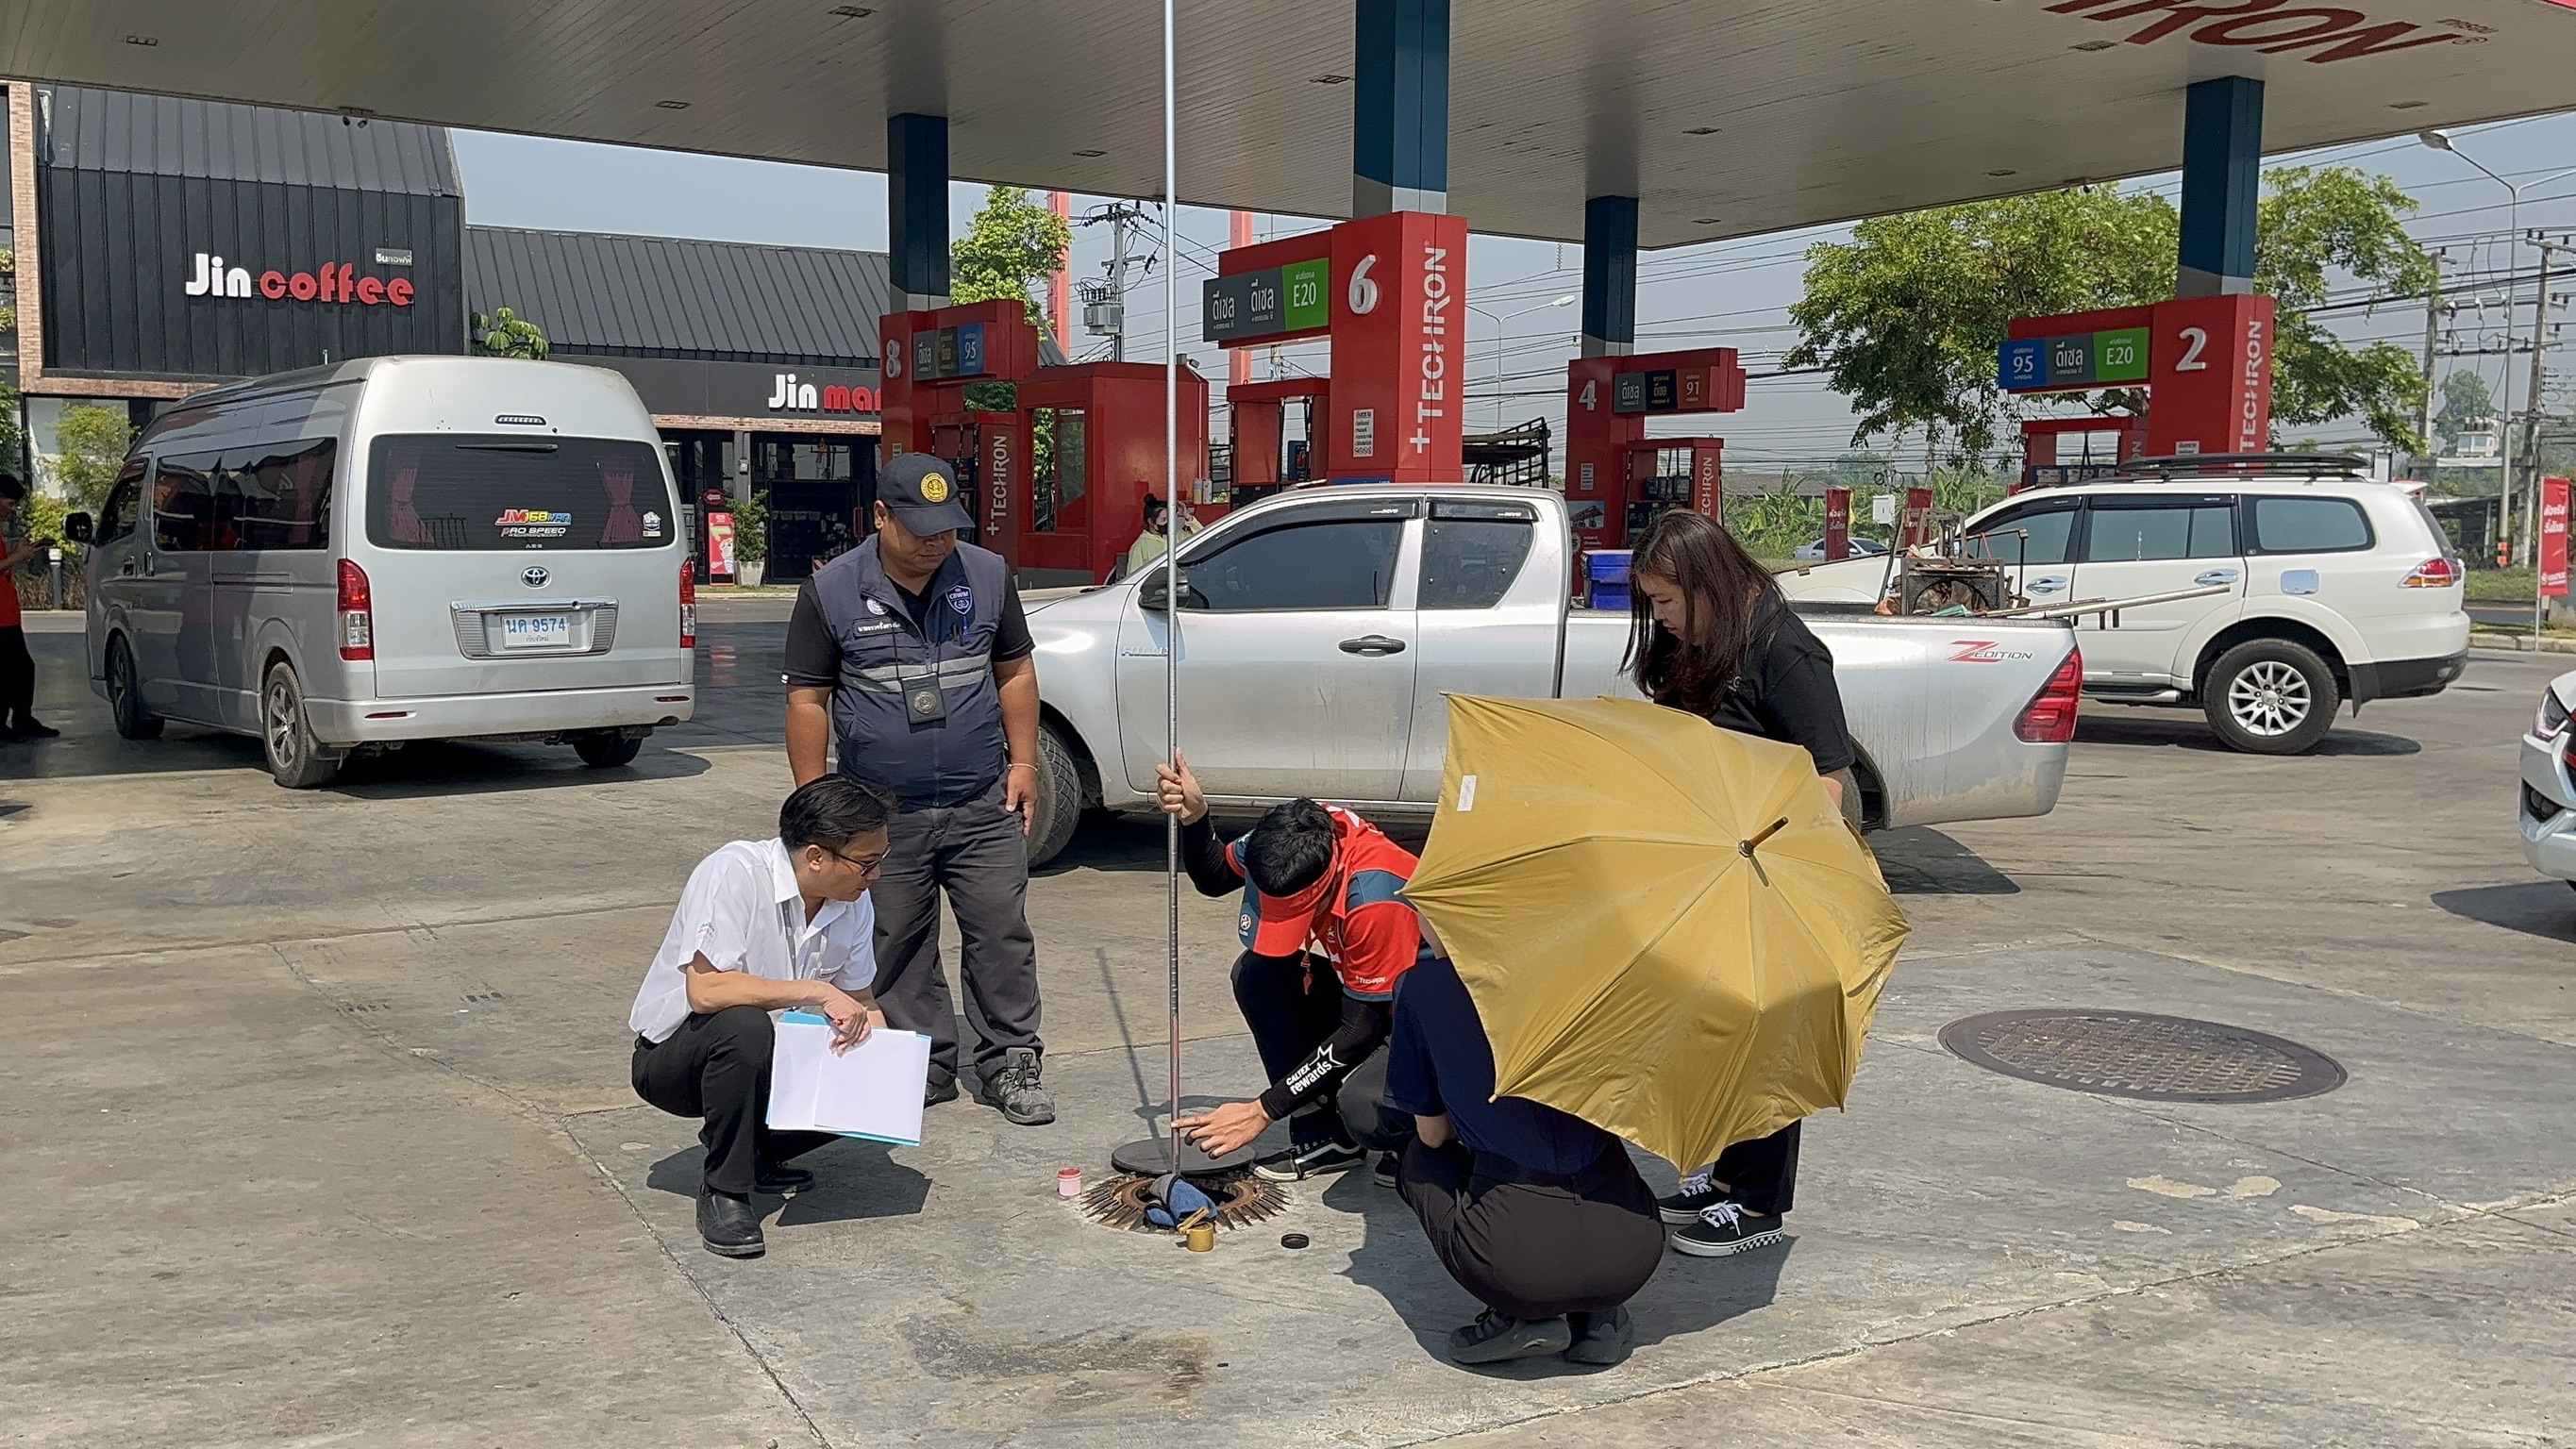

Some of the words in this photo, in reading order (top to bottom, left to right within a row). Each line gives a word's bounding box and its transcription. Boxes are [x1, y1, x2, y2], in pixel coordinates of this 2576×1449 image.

[186, 253, 251, 297] Jin
[260, 261, 414, 306] coffee
[1348, 254, 1378, 314] 6
[1213, 291, 1235, 321] ดีเซล
[1251, 278, 1274, 312] ดีเซล
[1293, 282, 1316, 308] E20
[886, 340, 901, 378] 8
[965, 341, 977, 358] 95
[2056, 341, 2083, 367] ดีเซล
[2106, 346, 2133, 365] E20
[2175, 327, 2206, 371] 2
[2014, 356, 2033, 373] 95
[768, 374, 817, 408] Jin
[1579, 379, 1597, 411] 4
[1686, 382, 1699, 395] 91
[1701, 457, 1715, 516] ECHRON
[532, 618, 566, 632] 9574
[1975, 651, 2033, 659] EDITION
[1286, 1063, 1310, 1086] CALTEX
[1290, 1060, 1332, 1094] rewards
